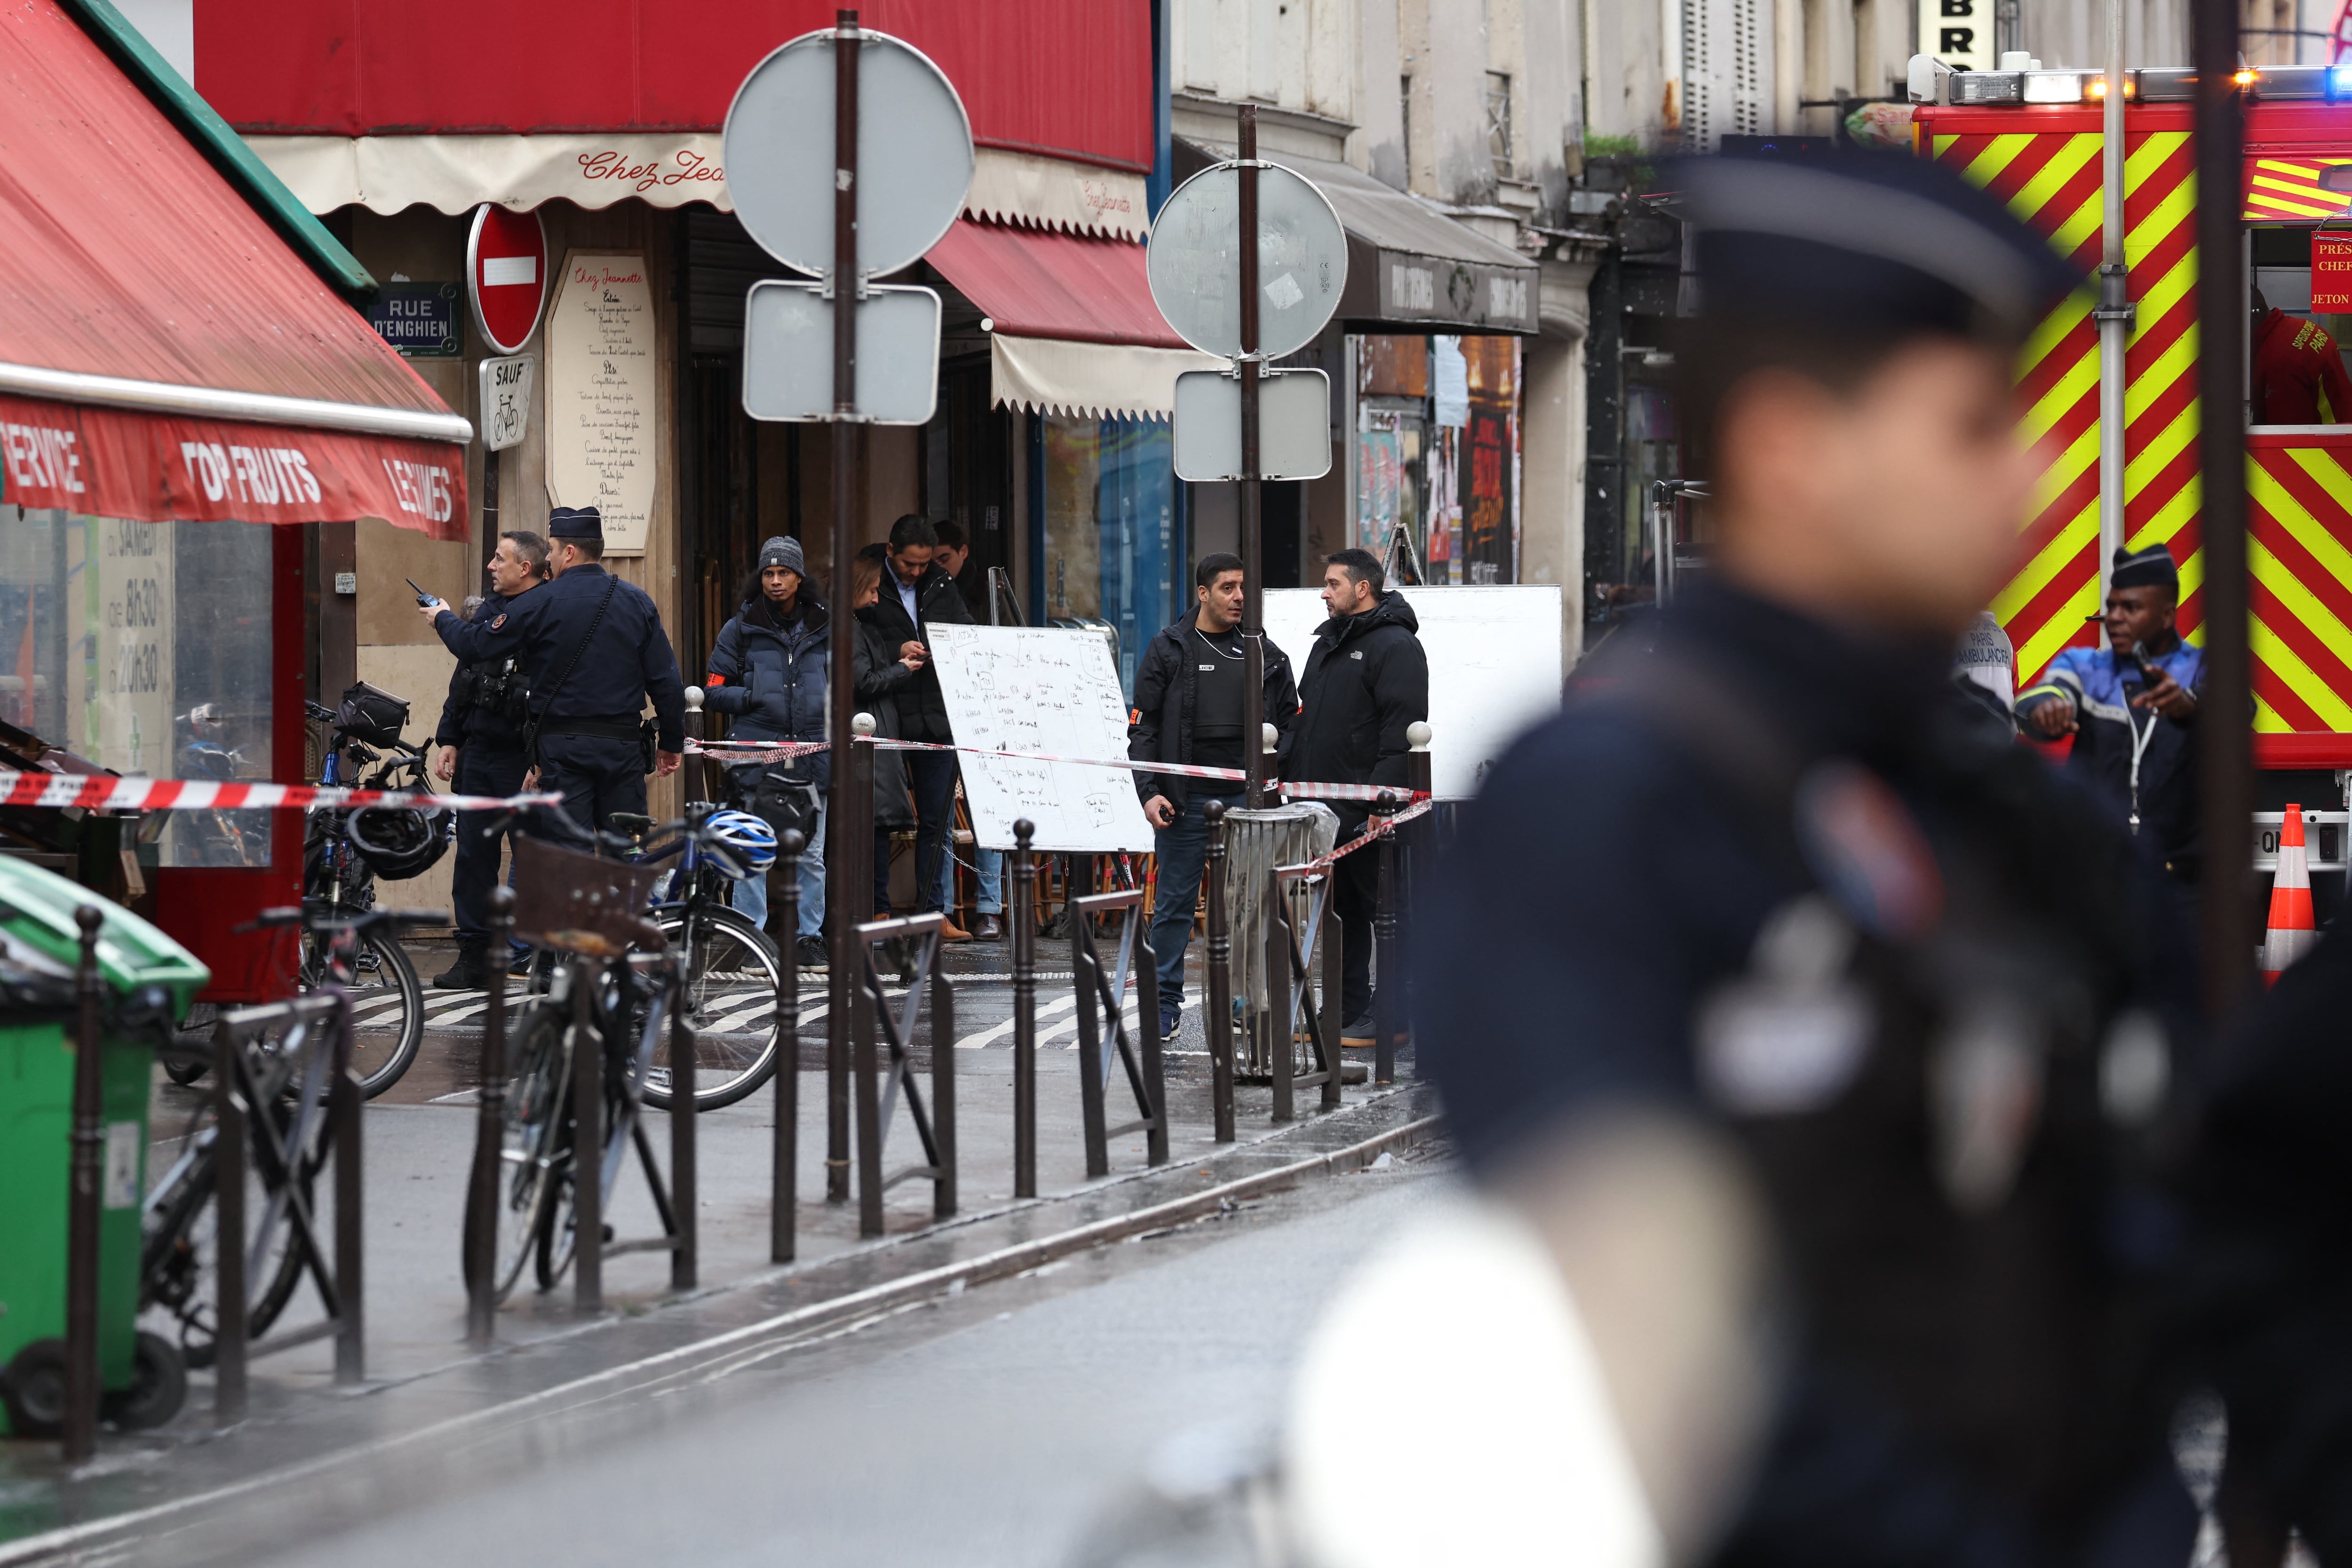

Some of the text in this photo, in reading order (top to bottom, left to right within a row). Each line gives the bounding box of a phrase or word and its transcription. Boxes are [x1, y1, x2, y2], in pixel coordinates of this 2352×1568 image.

[578, 151, 660, 191] Chez
[575, 267, 599, 291] Chez
[389, 300, 432, 316] RUE
[2312, 294, 2350, 304] JETON
[374, 320, 447, 337] D'ENGHIEN
[2309, 329, 2328, 354] PARIS
[496, 363, 523, 386] SAUF
[180, 442, 321, 505] TOP FRUITS
[1970, 632, 1994, 646] PARIS
